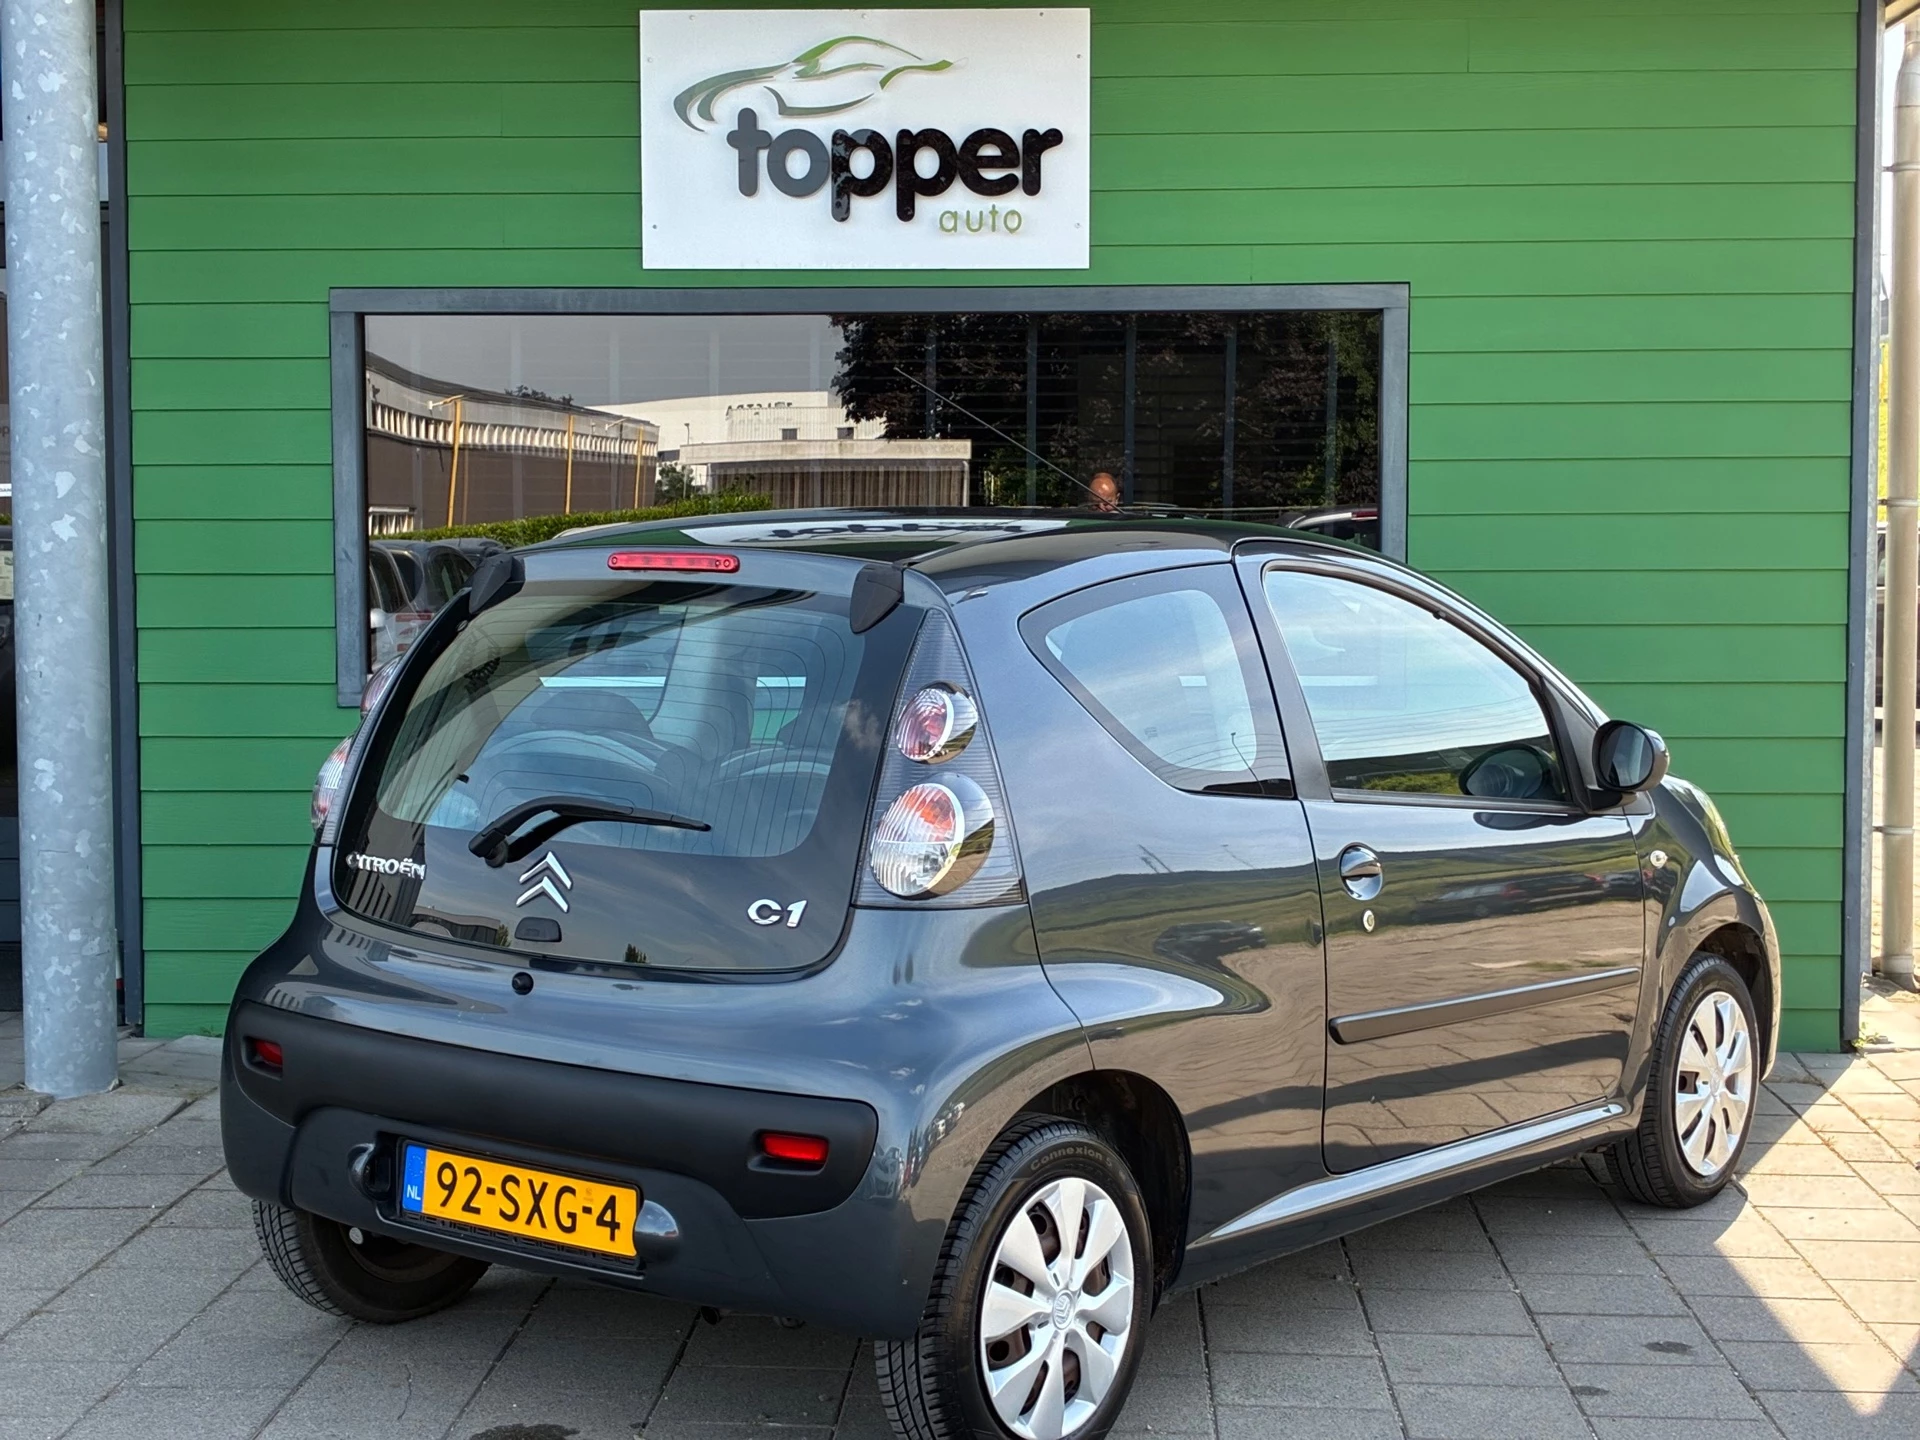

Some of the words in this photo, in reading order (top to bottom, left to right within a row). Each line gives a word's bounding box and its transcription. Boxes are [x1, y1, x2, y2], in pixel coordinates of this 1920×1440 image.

[726, 107, 1064, 222] topper
[939, 204, 1022, 233] auto
[747, 898, 808, 928] C1
[406, 1184, 421, 1200] NL
[436, 1161, 621, 1242] 92-SXG-4
